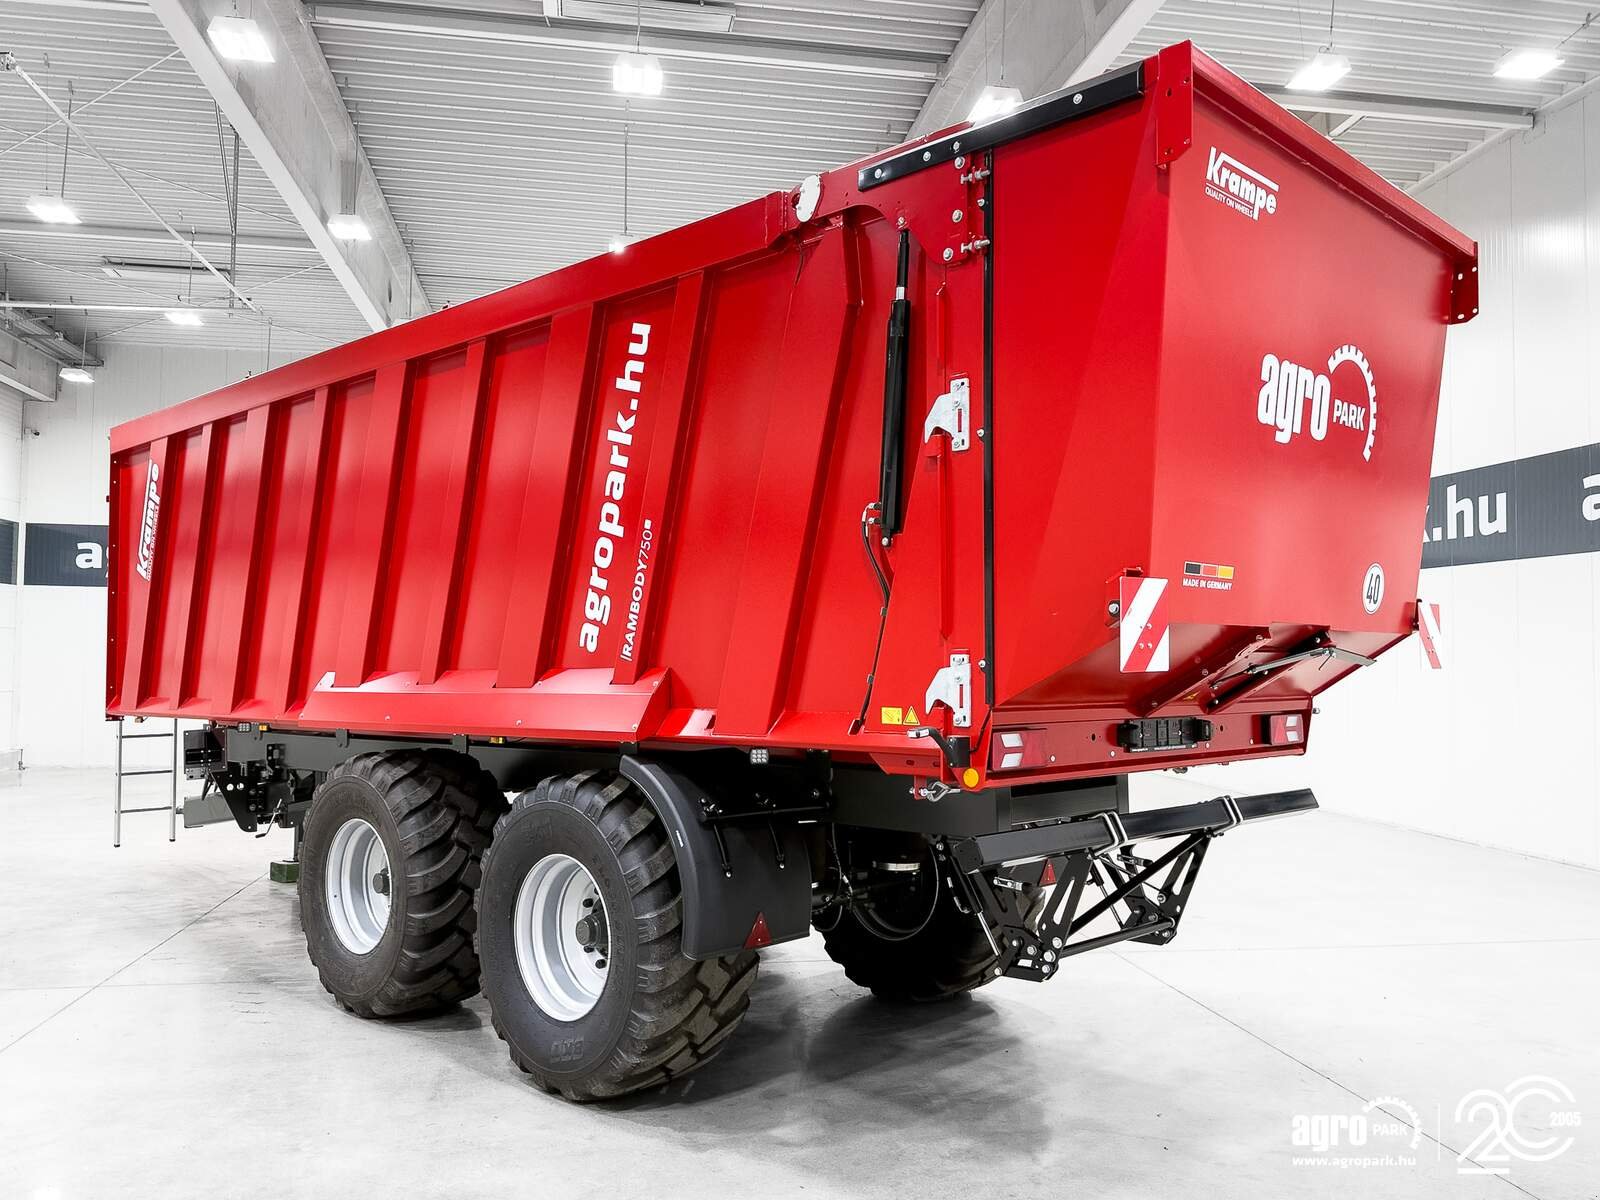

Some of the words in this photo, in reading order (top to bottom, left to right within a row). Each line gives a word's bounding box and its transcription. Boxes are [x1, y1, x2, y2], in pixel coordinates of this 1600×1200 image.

[1206, 146, 1279, 221] Krampe
[1257, 353, 1332, 444] agro
[1333, 399, 1367, 431] PARK
[579, 322, 651, 653] agropark.hu
[1423, 484, 1507, 543] .hu
[1183, 578, 1200, 587] MADE
[1200, 579, 1207, 588] IN
[1207, 580, 1233, 590] GERMANY
[1366, 573, 1381, 605] 40
